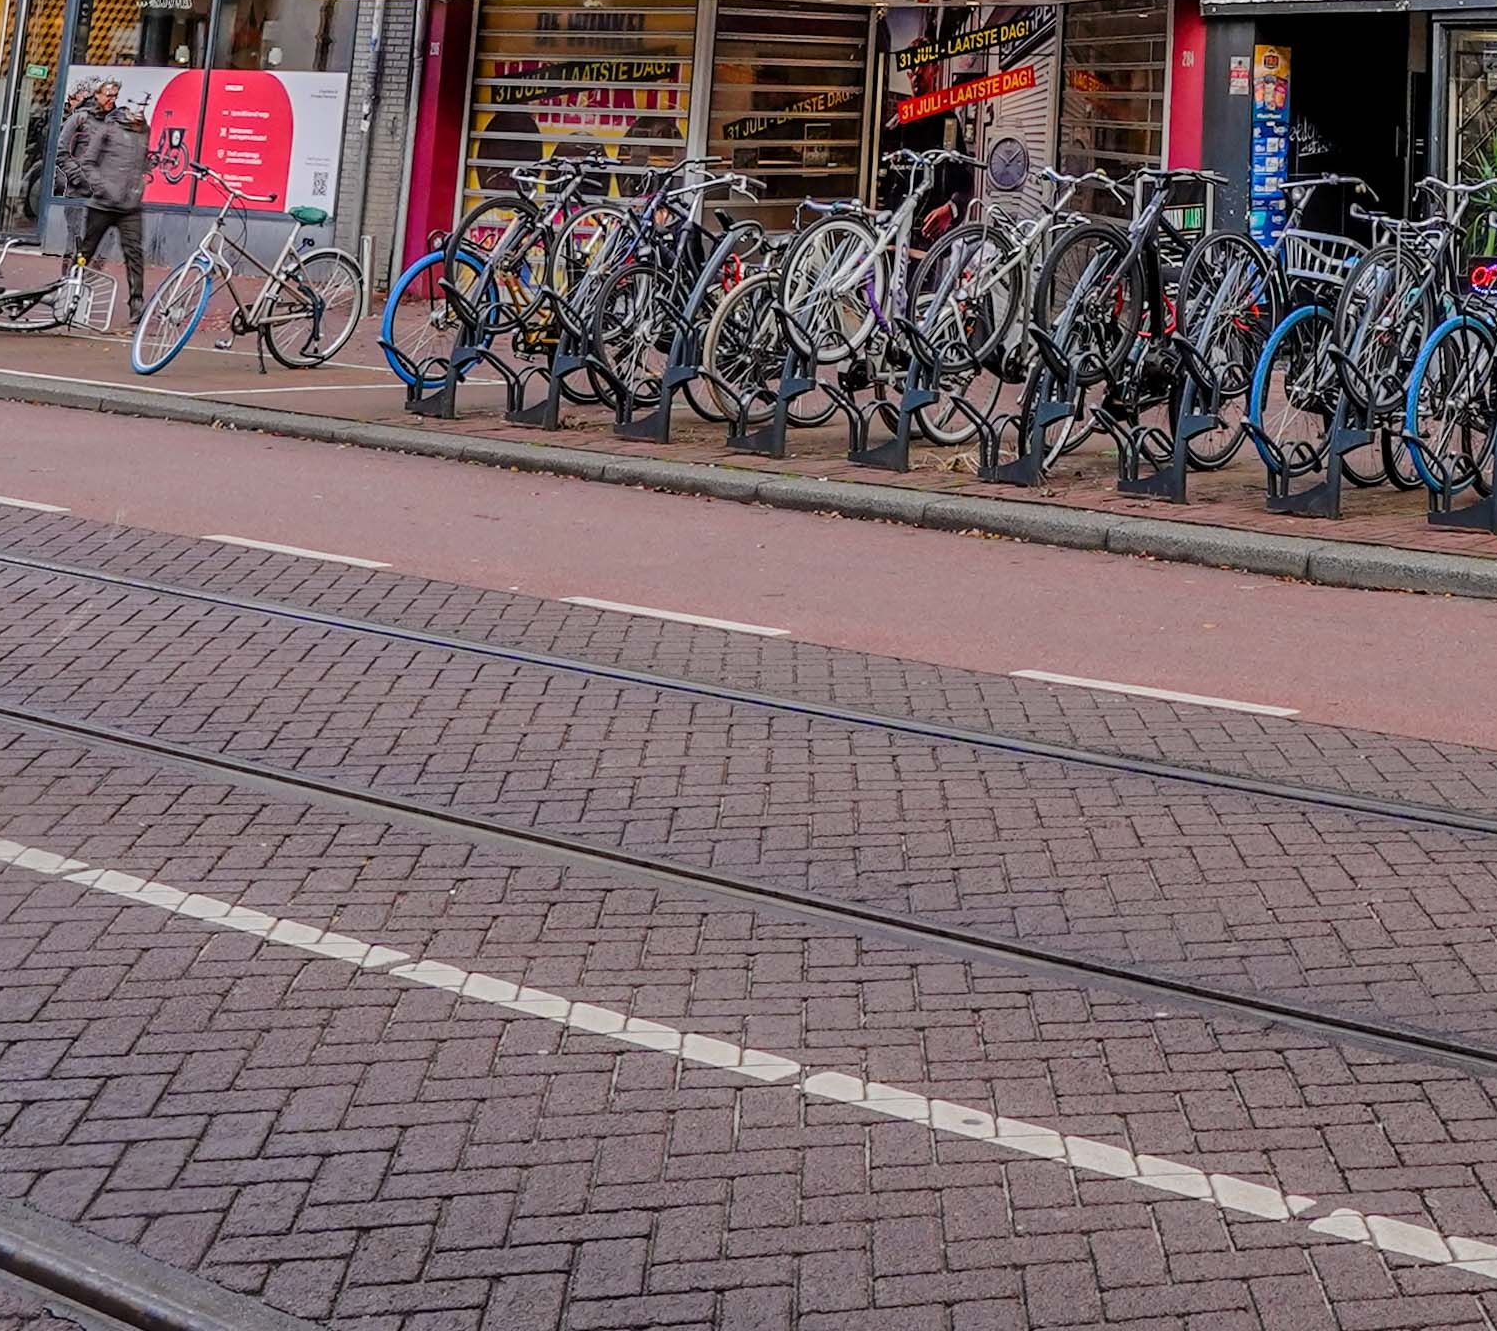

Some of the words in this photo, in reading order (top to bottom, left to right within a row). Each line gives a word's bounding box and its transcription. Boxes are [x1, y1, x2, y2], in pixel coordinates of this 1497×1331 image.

[899, 52, 911, 68] 31
[948, 27, 998, 55] LAATSTE
[1000, 20, 1030, 41] DAG!
[902, 104, 914, 120] 31
[916, 96, 941, 116] JULI
[950, 77, 1000, 105] LAATSTE
[1002, 70, 1033, 91] DAG!
